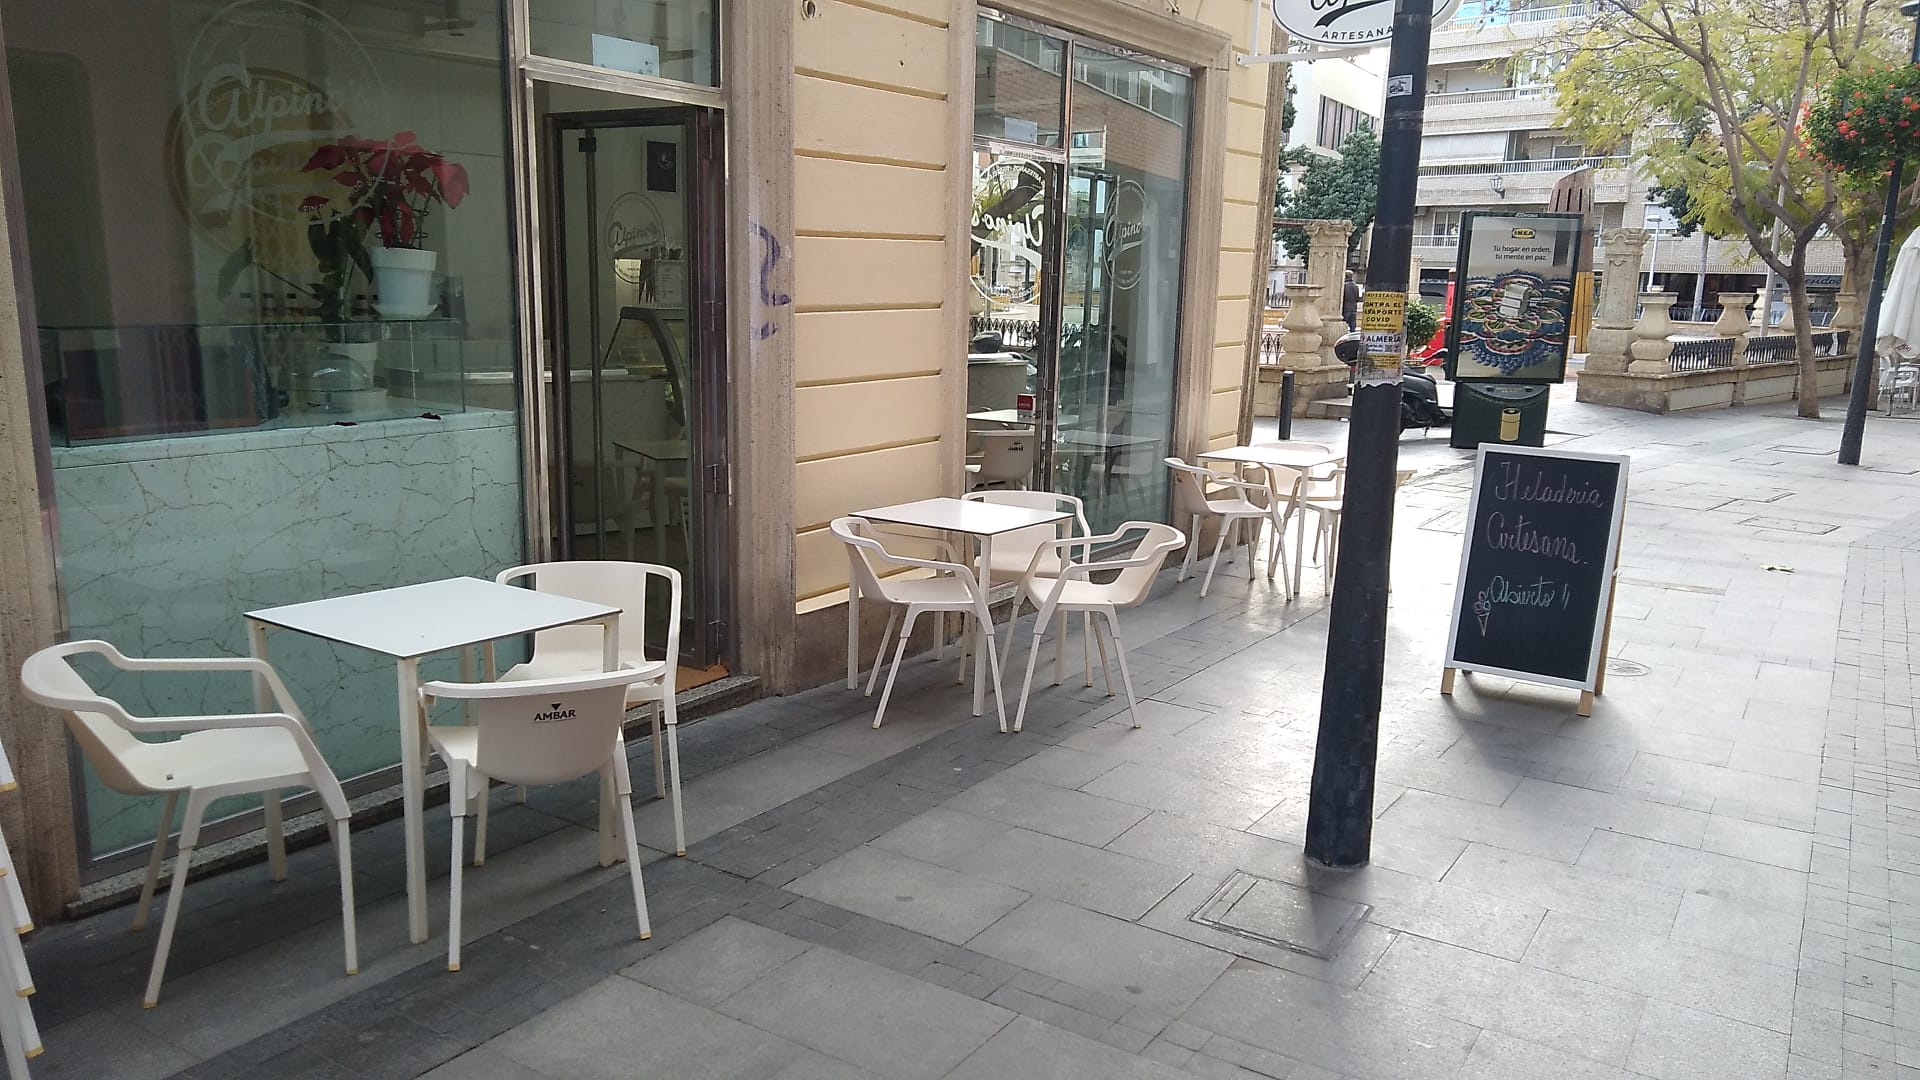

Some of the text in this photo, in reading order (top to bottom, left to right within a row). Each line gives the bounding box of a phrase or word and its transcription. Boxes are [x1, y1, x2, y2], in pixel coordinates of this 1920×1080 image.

[1321, 25, 1393, 40] ARTESANA
[197, 62, 352, 136] Alpin
[1502, 245, 1520, 254] hogar
[1490, 575, 1556, 607] Abierto
[534, 709, 576, 721] AMBAR
